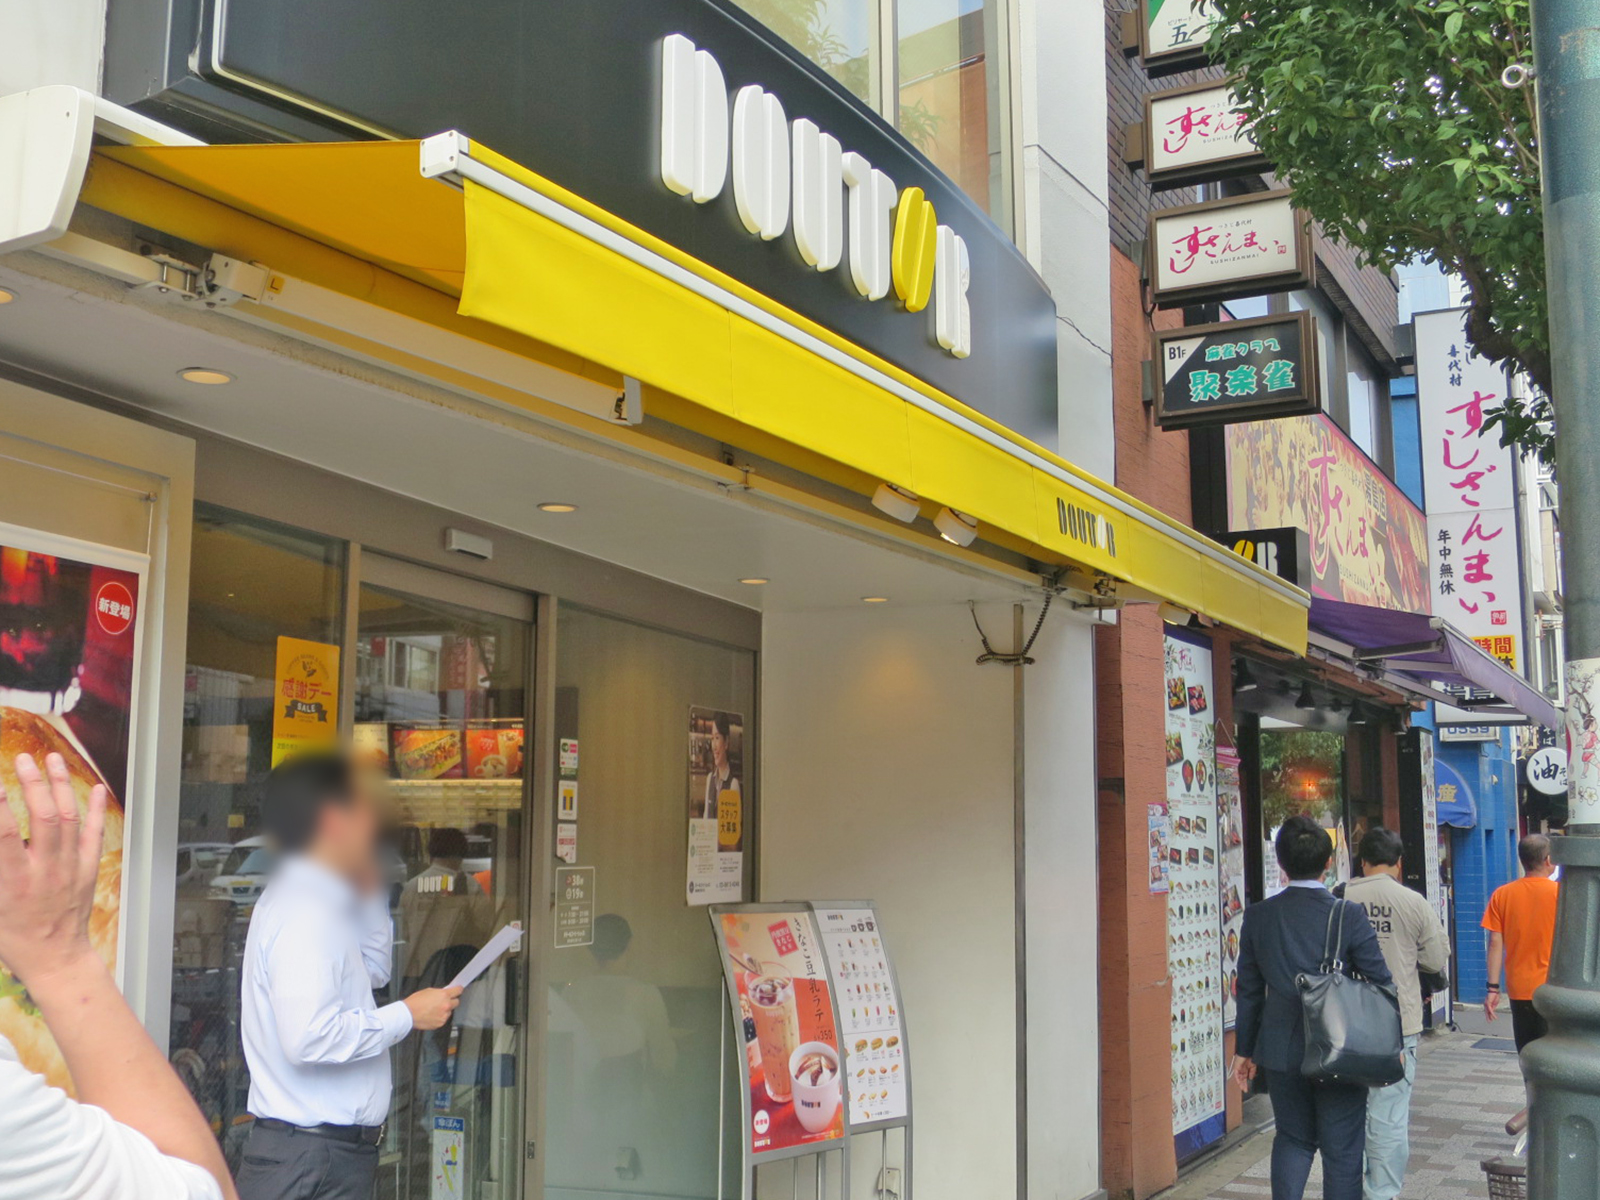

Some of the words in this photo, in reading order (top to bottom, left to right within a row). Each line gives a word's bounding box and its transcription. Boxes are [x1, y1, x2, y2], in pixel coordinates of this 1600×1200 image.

[660, 33, 972, 360] DOUTOR
[1167, 345, 1188, 361] B1F
[1441, 389, 1504, 615] すしざんまい
[1056, 496, 1117, 559] DOUTOR
[1436, 529, 1456, 597] 年中無休
[97, 596, 132, 621] 新登場
[281, 677, 333, 701] 感謝デー
[296, 701, 316, 714] SALE
